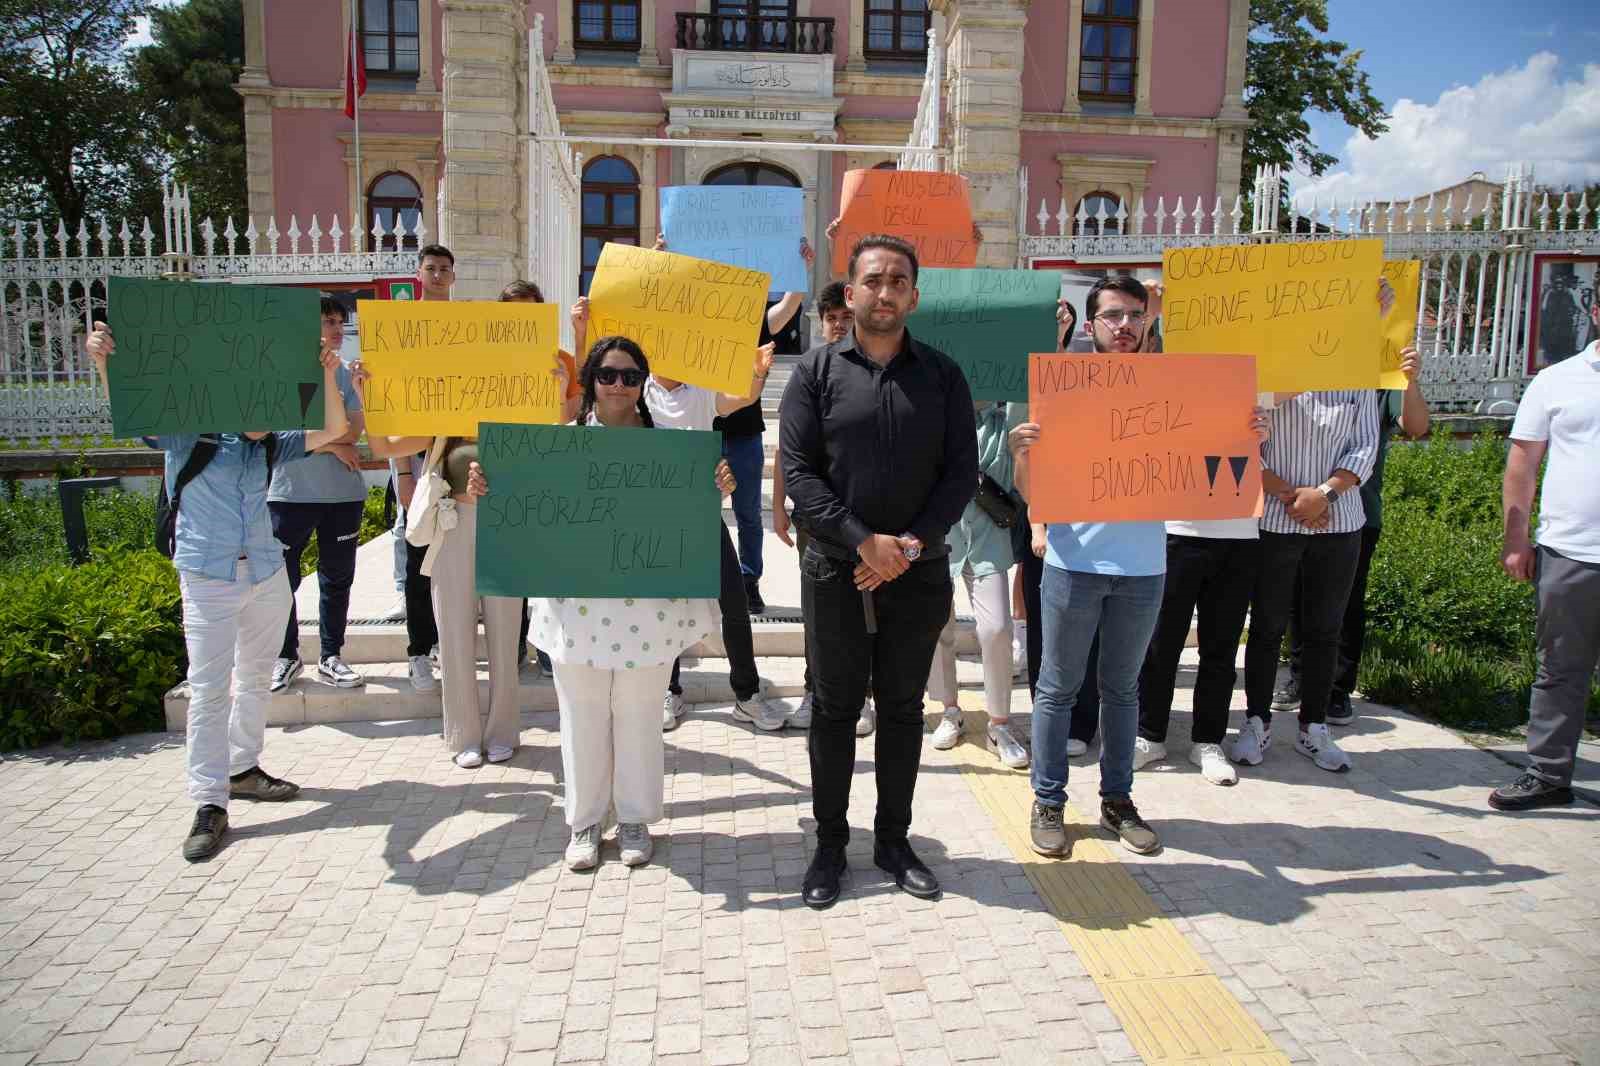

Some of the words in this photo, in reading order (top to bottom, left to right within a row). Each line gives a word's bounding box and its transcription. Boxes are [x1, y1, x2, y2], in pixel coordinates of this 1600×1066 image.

[632, 276, 698, 314] YALAN
[701, 289, 765, 327] OLDU
[122, 332, 194, 379] YER
[207, 330, 282, 377] YOK
[119, 382, 216, 432] ZAM
[481, 428, 594, 459] ARAÇLAR
